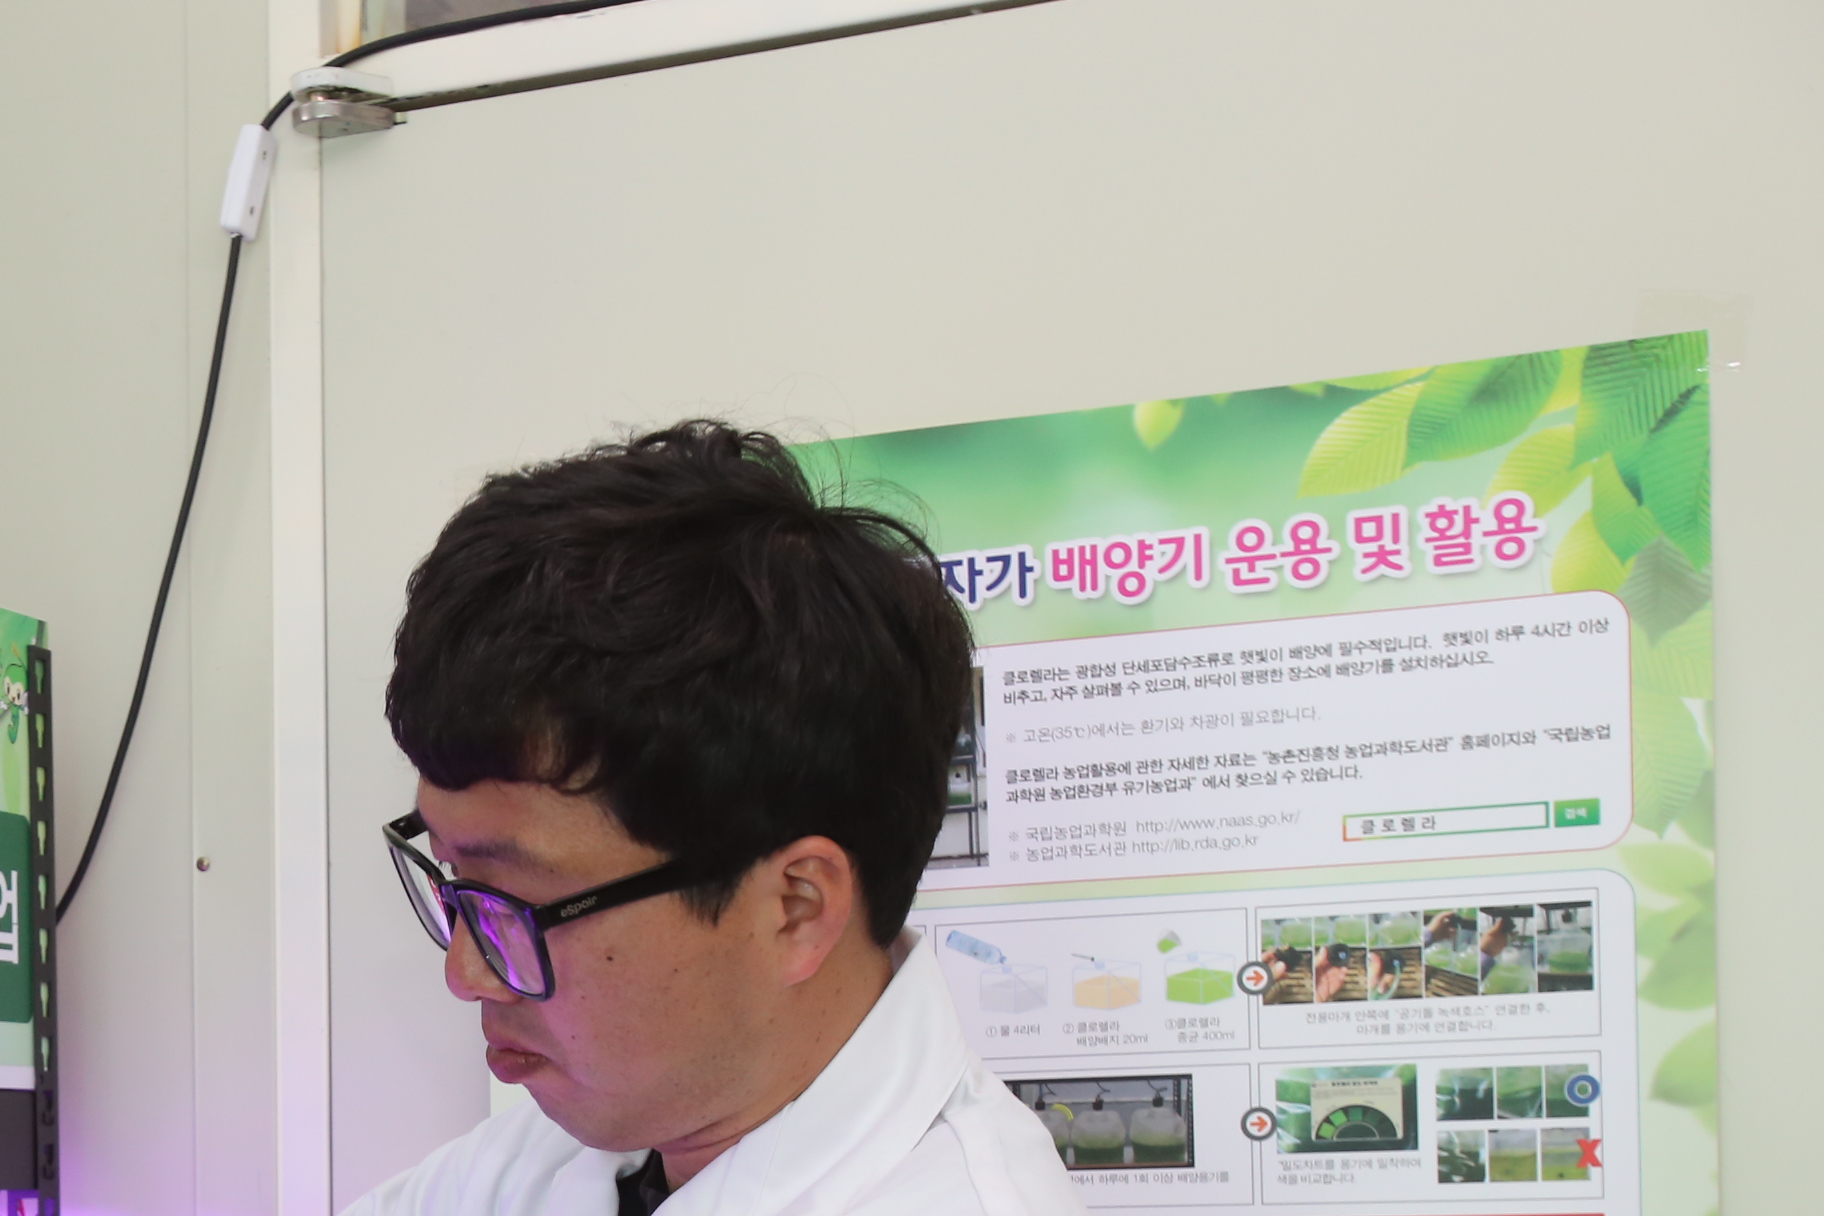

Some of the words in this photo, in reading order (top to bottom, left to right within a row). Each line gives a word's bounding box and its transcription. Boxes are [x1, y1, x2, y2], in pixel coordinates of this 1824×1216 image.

[1051, 535, 1206, 600] 배양기
[1223, 523, 1334, 591] 운용
[1352, 512, 1404, 577] 및
[1424, 495, 1540, 574] 활용
[1003, 668, 1070, 686] 클로렐라는
[1075, 662, 1116, 679] 광합성
[1122, 653, 1235, 675] 단세포담수조류로
[1240, 648, 1282, 665] 햇빛이
[1289, 643, 1332, 660] 배양에
[1339, 635, 1432, 656] 필수적입니다.
[1443, 629, 1488, 647] 햇빛이
[1495, 625, 1526, 642] 하루
[1531, 621, 1572, 637] 4시간
[1579, 618, 1610, 634] 이상
[1004, 690, 1047, 705] 비추고,
[1051, 686, 1078, 700] 자주
[1082, 682, 1123, 699] 살펴볼
[1126, 681, 1141, 695] 수
[1145, 677, 1190, 693] 있으며,
[1194, 672, 1236, 688] 바닥이
[1241, 668, 1284, 685] 평평한
[1288, 664, 1331, 681] 장소에
[1336, 658, 1395, 676] 배양기를
[1399, 651, 1494, 672] 설치하십시오.
[1141, 717, 1184, 734] 환기와
[1190, 713, 1234, 729] 차광이
[1240, 706, 1320, 727] 필요합니다.
[1005, 767, 1059, 784] 클로렐라
[1063, 762, 1131, 780] 농업활용에
[1136, 759, 1163, 774] 관한
[1168, 755, 1209, 771] 자세한
[1214, 753, 1257, 768] 자료는
[1460, 730, 1537, 750] 홈페이지와
[1006, 788, 1045, 803] 과학원
[1049, 783, 1118, 800] 농업환경부
[1202, 774, 1230, 789] 에서
[1235, 771, 1277, 787] 찾으실
[1282, 770, 1296, 784] 수
[1301, 765, 1362, 783] 있습니다.
[1026, 822, 1126, 842] 국립농업과학원
[1026, 842, 1126, 862] 농업과학도서관
[1495, 1003, 1530, 1016] 연결한
[1014, 1024, 1040, 1035] 4리터
[1078, 1021, 1119, 1033] 클로렐라
[1202, 1031, 1234, 1040] 400ml
[1123, 1034, 1148, 1044] 20ml
[1099, 1173, 1129, 1185] 하루에
[1134, 1173, 1148, 1184] 1회
[1154, 1172, 1173, 1184] 이상
[1178, 1171, 1229, 1183] 배양용기를
